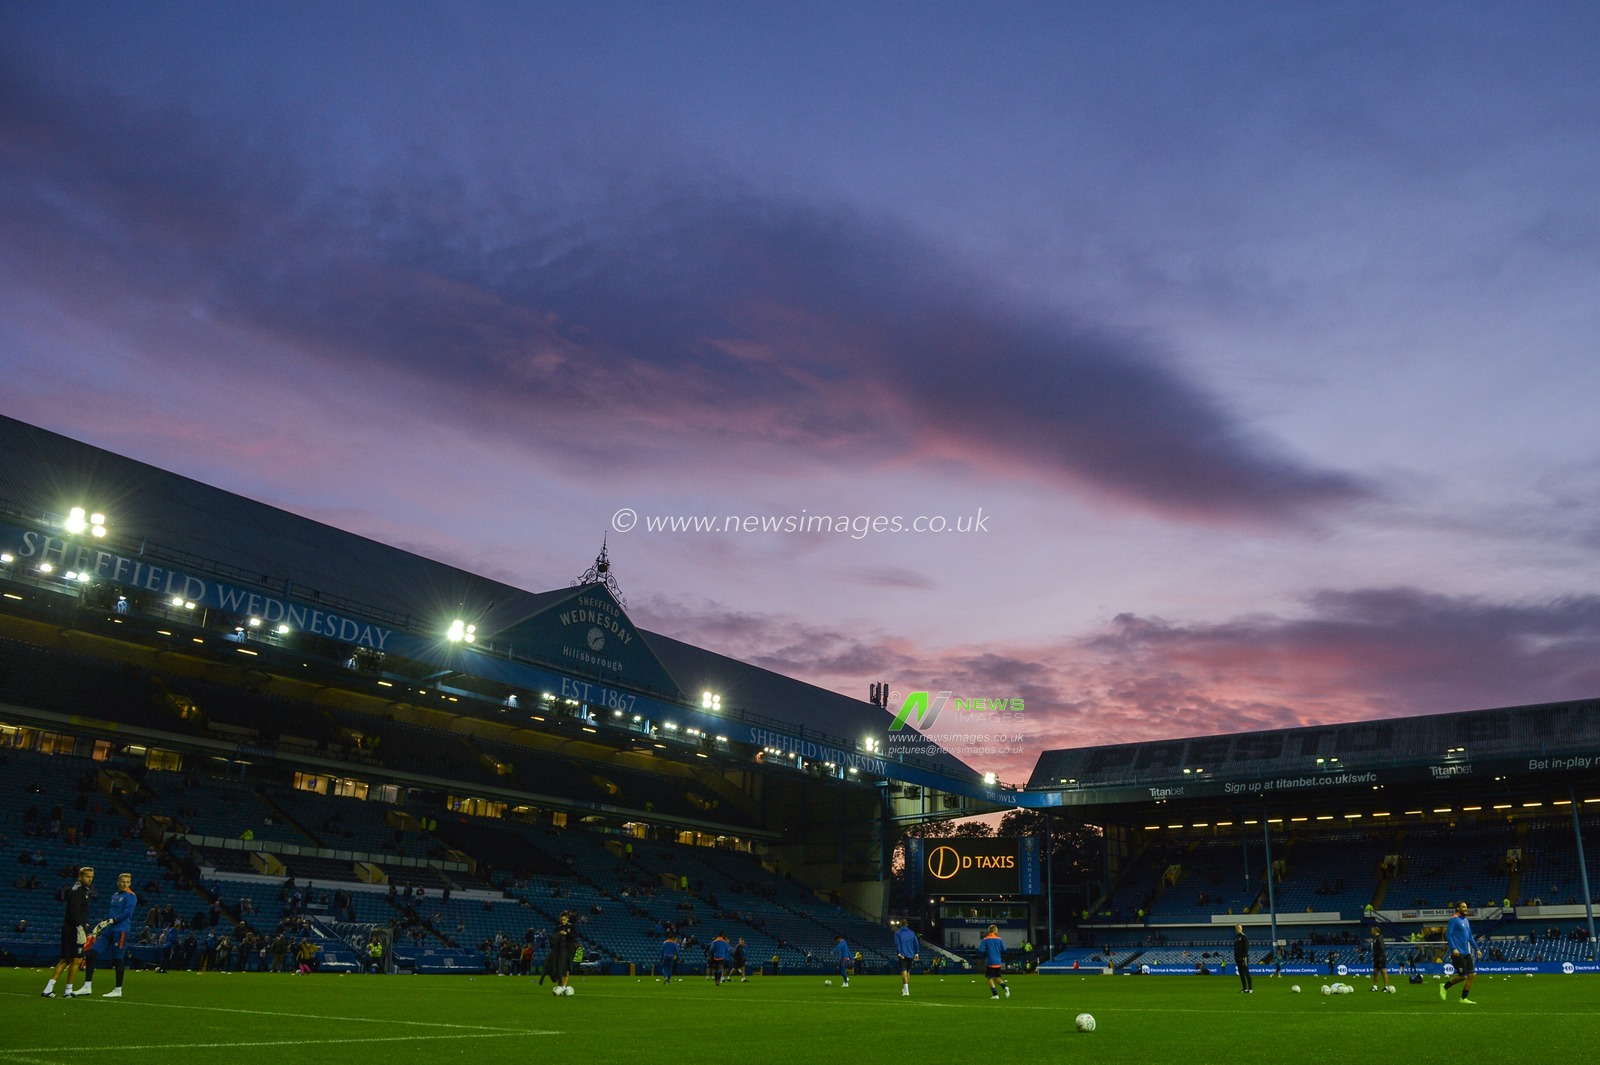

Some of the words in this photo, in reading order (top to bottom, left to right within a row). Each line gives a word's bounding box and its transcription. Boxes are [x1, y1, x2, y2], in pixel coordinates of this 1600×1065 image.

[18, 530, 206, 602] SHEFFIELD
[217, 584, 392, 650] WEDNESDAY
[578, 596, 620, 618] SHEFFIELD
[560, 609, 632, 645] WEDNESDAY
[563, 646, 623, 671] Hillsborough
[561, 677, 594, 702] EST.
[600, 688, 637, 713] 1867
[750, 727, 817, 758] SHEFFIELD
[819, 745, 888, 776] WEDNESDAY
[1428, 763, 1473, 776] Titanbet
[1529, 759, 1549, 770] Bet
[1552, 756, 1592, 770] in-play
[1149, 786, 1185, 797] Titanbet
[1224, 782, 1246, 794] Sign
[1248, 782, 1262, 791] up
[1264, 780, 1274, 790] at
[1276, 772, 1377, 789] titanbet.co.uk/swfc
[985, 790, 996, 800] THE
[996, 794, 1017, 803] OWLS
[962, 856, 972, 869] D
[975, 855, 1015, 869] TAXIS
